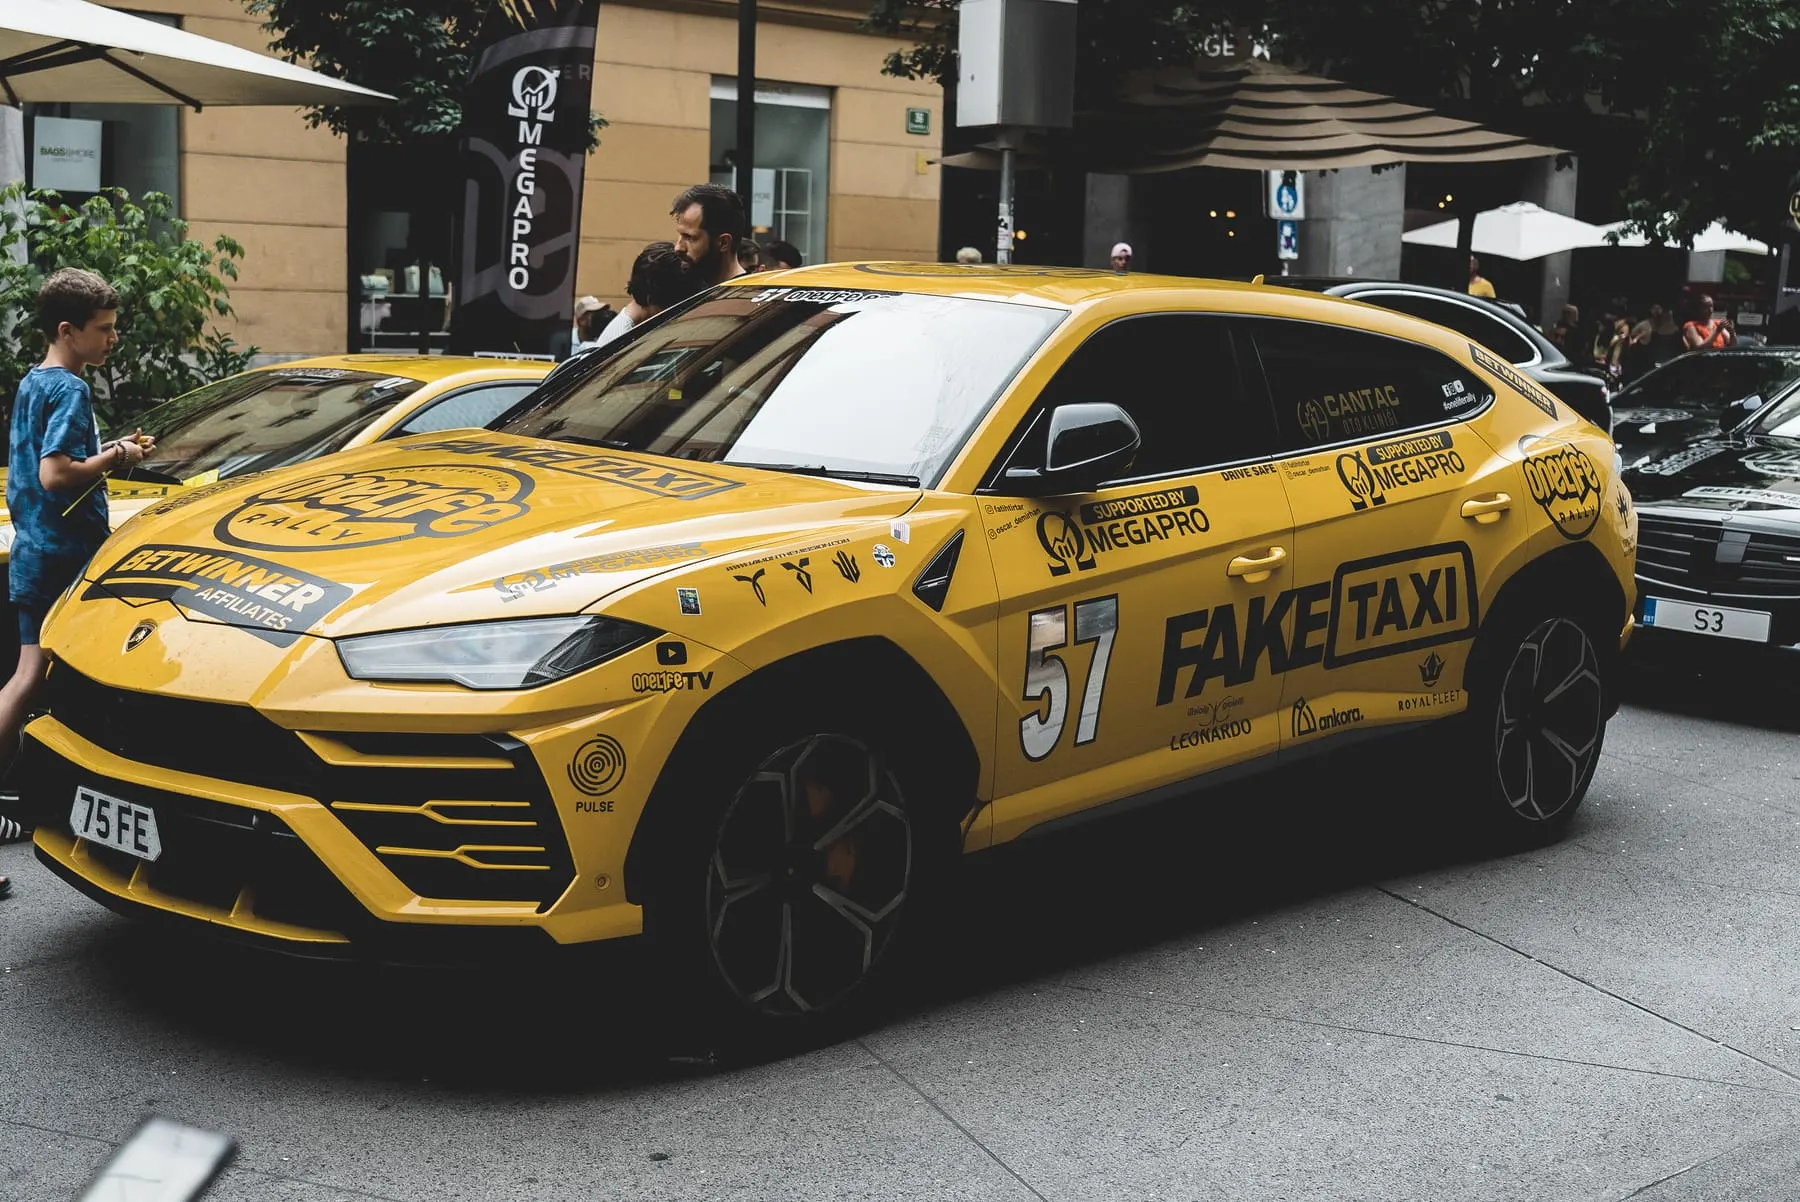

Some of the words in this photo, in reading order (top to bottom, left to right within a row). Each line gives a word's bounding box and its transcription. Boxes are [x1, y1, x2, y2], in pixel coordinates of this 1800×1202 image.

[508, 119, 543, 290] MEGAPRO
[1474, 348, 1552, 408] BETWINNER
[1376, 437, 1430, 461] SUPPORTED
[1428, 434, 1444, 450] BY
[578, 459, 718, 493] TAXI
[1221, 467, 1252, 482] DRIVE
[1251, 463, 1278, 478] SAFE
[1372, 450, 1466, 491] MEGAPRO
[1092, 496, 1168, 520] SUPPORTED
[1167, 491, 1186, 506] BY
[1559, 504, 1595, 523] RALLY
[239, 513, 363, 541] RALLY
[1083, 507, 1211, 555] MEGAPRO
[115, 549, 327, 613] BETWINNER
[552, 546, 709, 581] MEGAPRO
[194, 586, 294, 632] AFFILIATES
[1693, 608, 1725, 633] S3
[1156, 580, 1332, 707] FAKE
[1348, 566, 1457, 641] TAXI
[1018, 593, 1119, 763] 57
[1170, 718, 1253, 752] LEONARDO
[80, 792, 111, 840] 75
[117, 804, 150, 854] FE
[576, 800, 615, 813] PULSE
